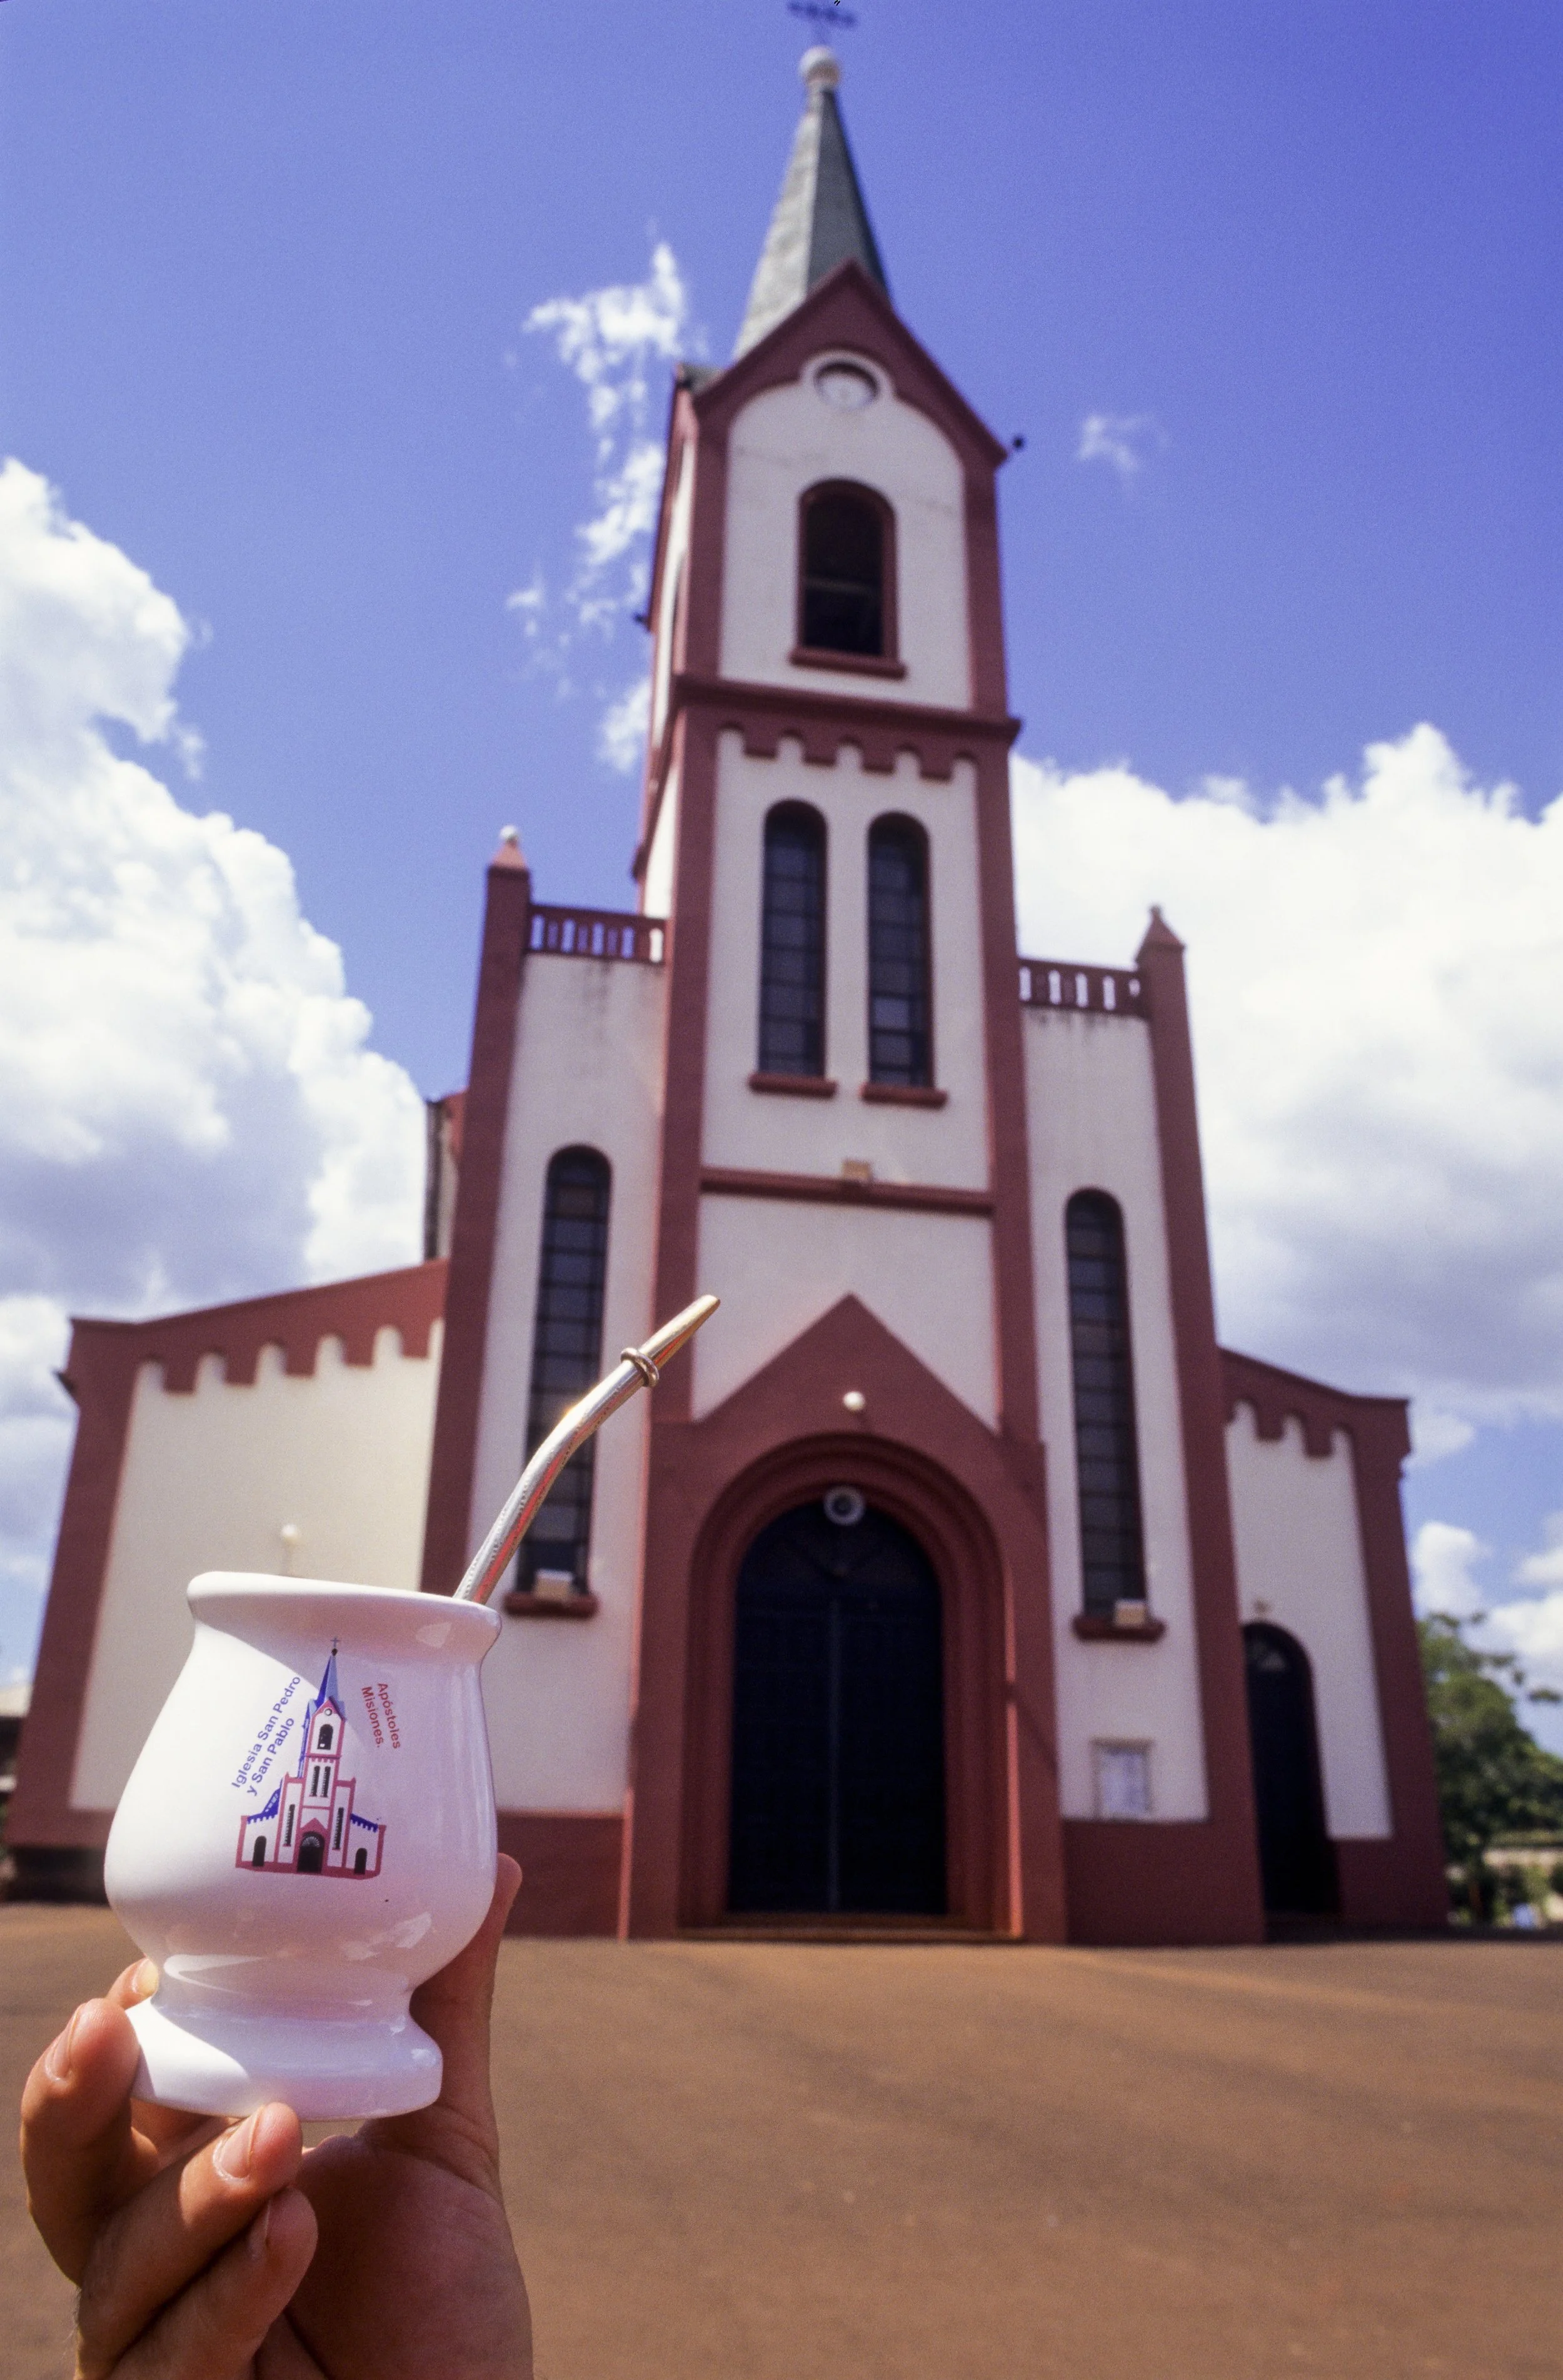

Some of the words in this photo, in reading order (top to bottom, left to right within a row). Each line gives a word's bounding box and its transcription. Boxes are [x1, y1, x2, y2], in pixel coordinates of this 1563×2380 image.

[231, 1743, 262, 1788] Iglesia
[258, 1715, 278, 1740] San
[273, 1677, 300, 1713] Pedro
[267, 1718, 294, 1755] Pablo
[361, 1686, 384, 1747] Misiones.
[378, 1683, 400, 1749] Apóstoles
[247, 1785, 258, 1797] y
[251, 1757, 273, 1783] San
